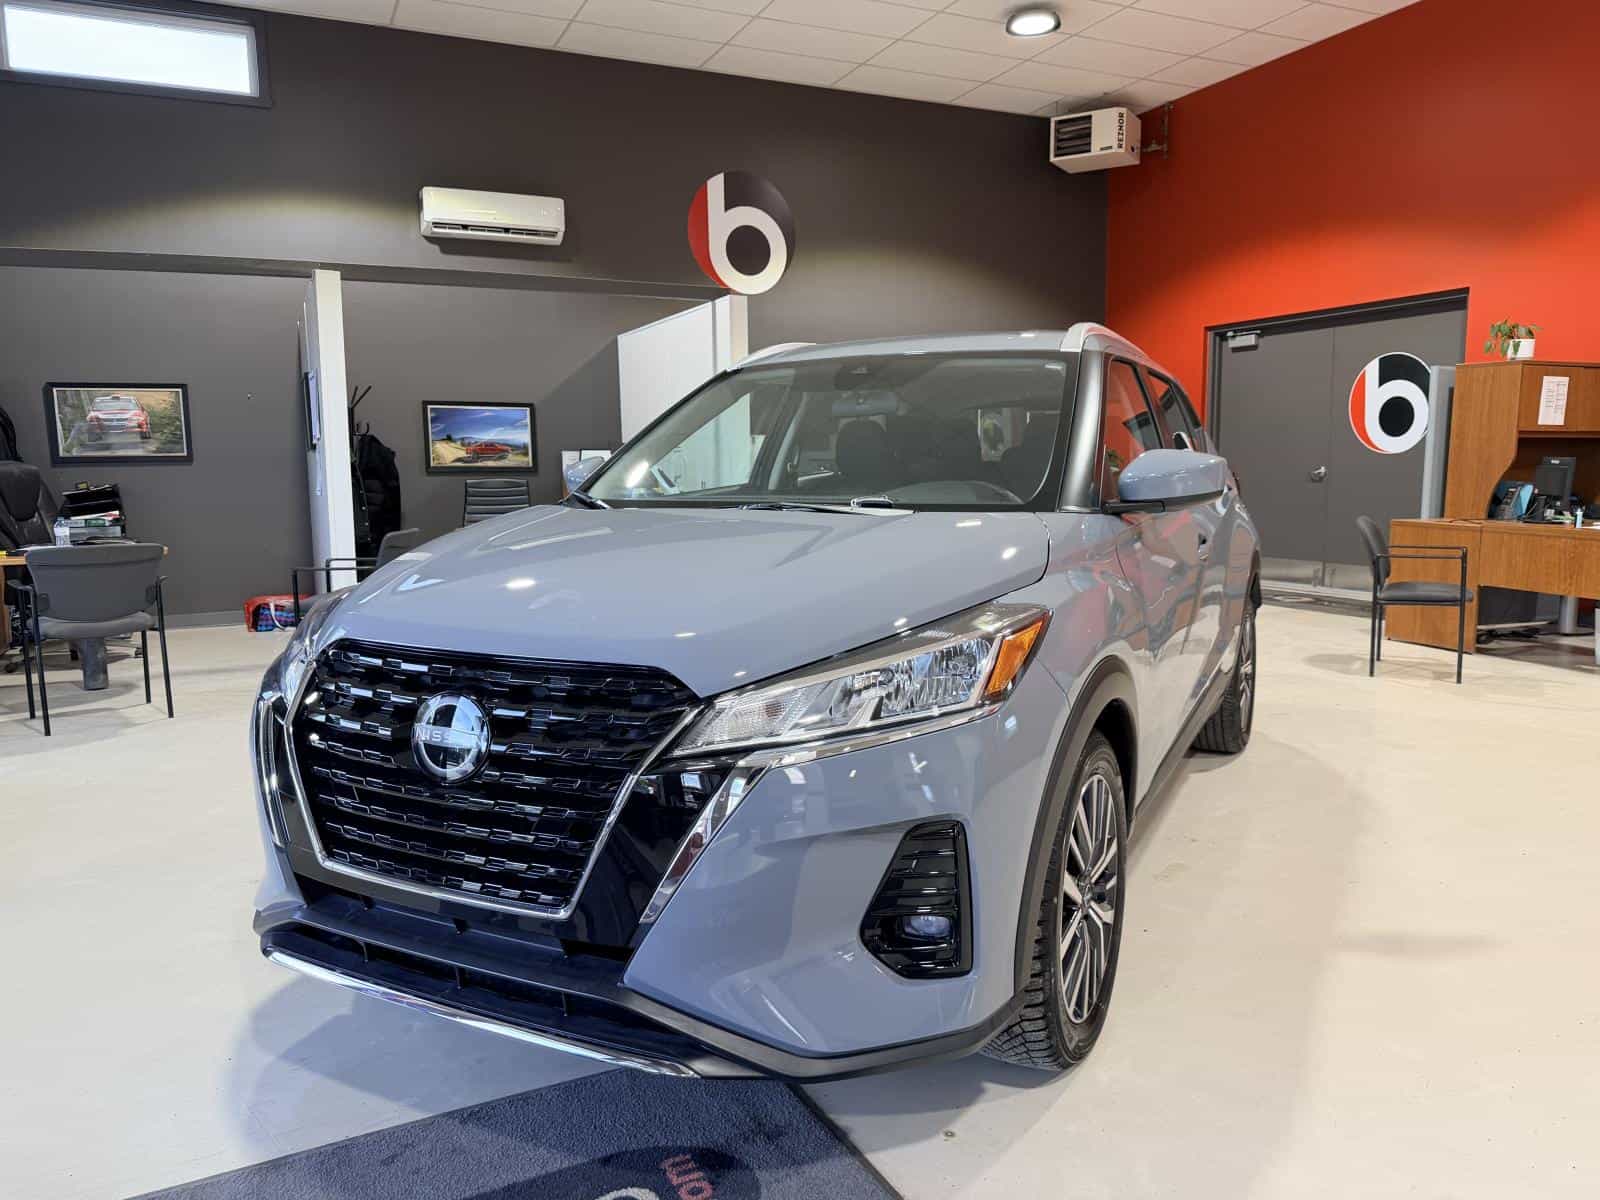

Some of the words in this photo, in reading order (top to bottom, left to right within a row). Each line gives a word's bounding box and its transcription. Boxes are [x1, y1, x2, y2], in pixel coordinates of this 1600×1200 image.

[1117, 111, 1125, 149] REZNOR
[705, 171, 788, 295] b
[1363, 352, 1430, 454] b
